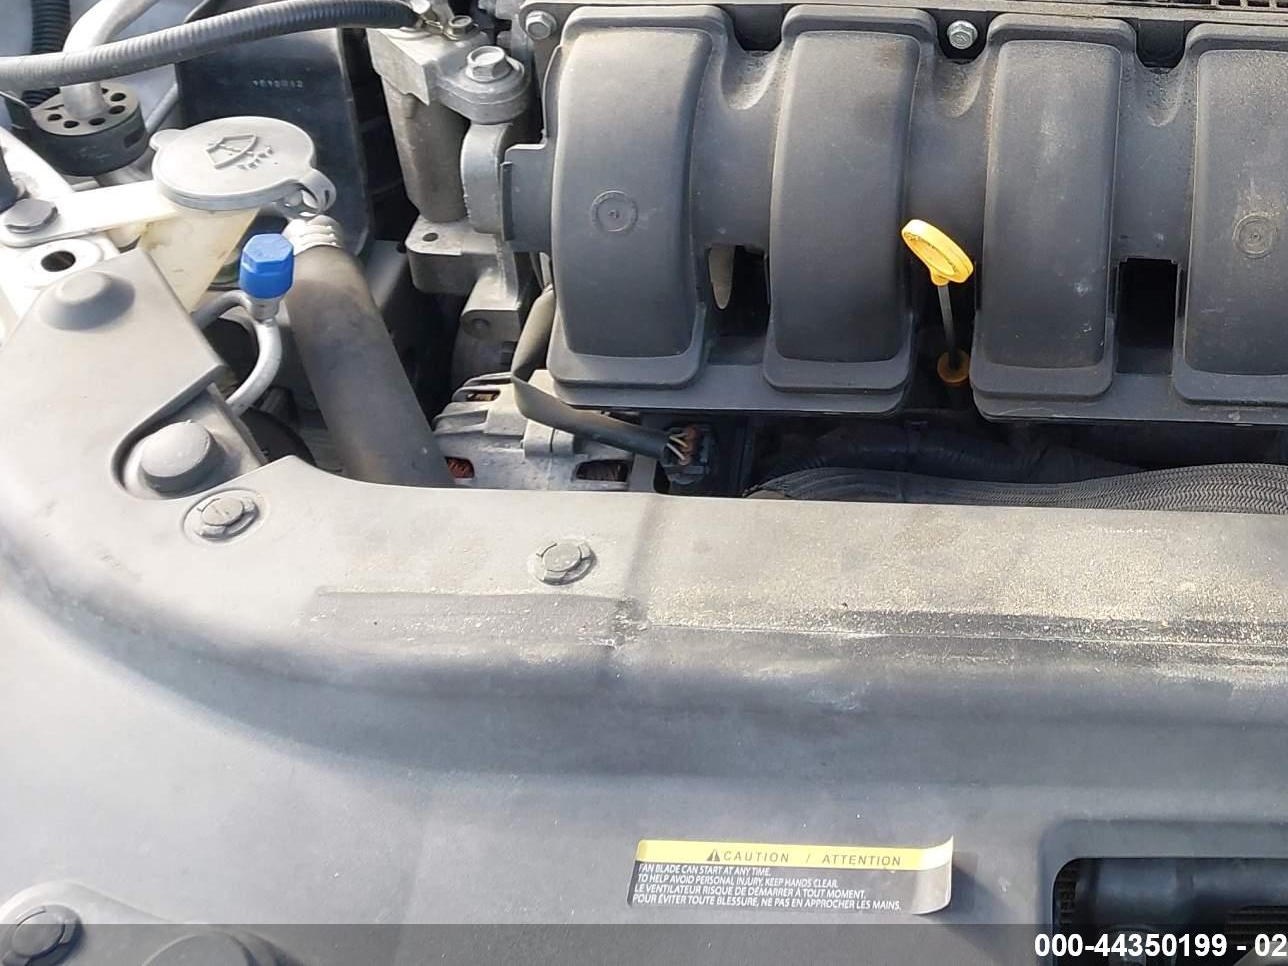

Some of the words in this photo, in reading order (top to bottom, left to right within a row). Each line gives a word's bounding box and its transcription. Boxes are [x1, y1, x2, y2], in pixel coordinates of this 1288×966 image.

[723, 851, 789, 862] CAUTION
[806, 853, 810, 863] /
[822, 854, 901, 866] ATTENTION
[639, 863, 654, 872] FAN
[656, 864, 680, 873] BLADE
[682, 865, 698, 873] CAN
[700, 866, 723, 874] START
[724, 867, 733, 875] AT
[734, 867, 751, 875] ANY
[752, 867, 771, 876] TIME.
[638, 874, 648, 882] TO
[650, 874, 669, 883] HELP
[670, 875, 693, 884] AVOID
[696, 876, 734, 885] PERSONAL
[765, 877, 784, 886] KEEP
[785, 878, 811, 887] HANDS
[813, 879, 838, 888] CLEAR.
[634, 884, 645, 893] LE
[646, 884, 701, 894] VENTILATEUR
[703, 886, 733, 896] RISQUE
[735, 887, 746, 895] DE
[747, 886, 793, 897] DÉMARRER
[803, 889, 825, 898] TOUT
[827, 889, 866, 899] MOMENT.
[632, 893, 656, 903] POUR
[658, 892, 687, 904] ÉVITER
[688, 895, 714, 905] TOUTE
[716, 896, 759, 906] BLESSURE,
[761, 898, 772, 906] NE
[774, 898, 789, 907] PAS
[791, 898, 803, 907] EN
[804, 899, 855, 909] APPROCHER
[856, 900, 870, 909] LES
[872, 900, 901, 910] MAINS.
